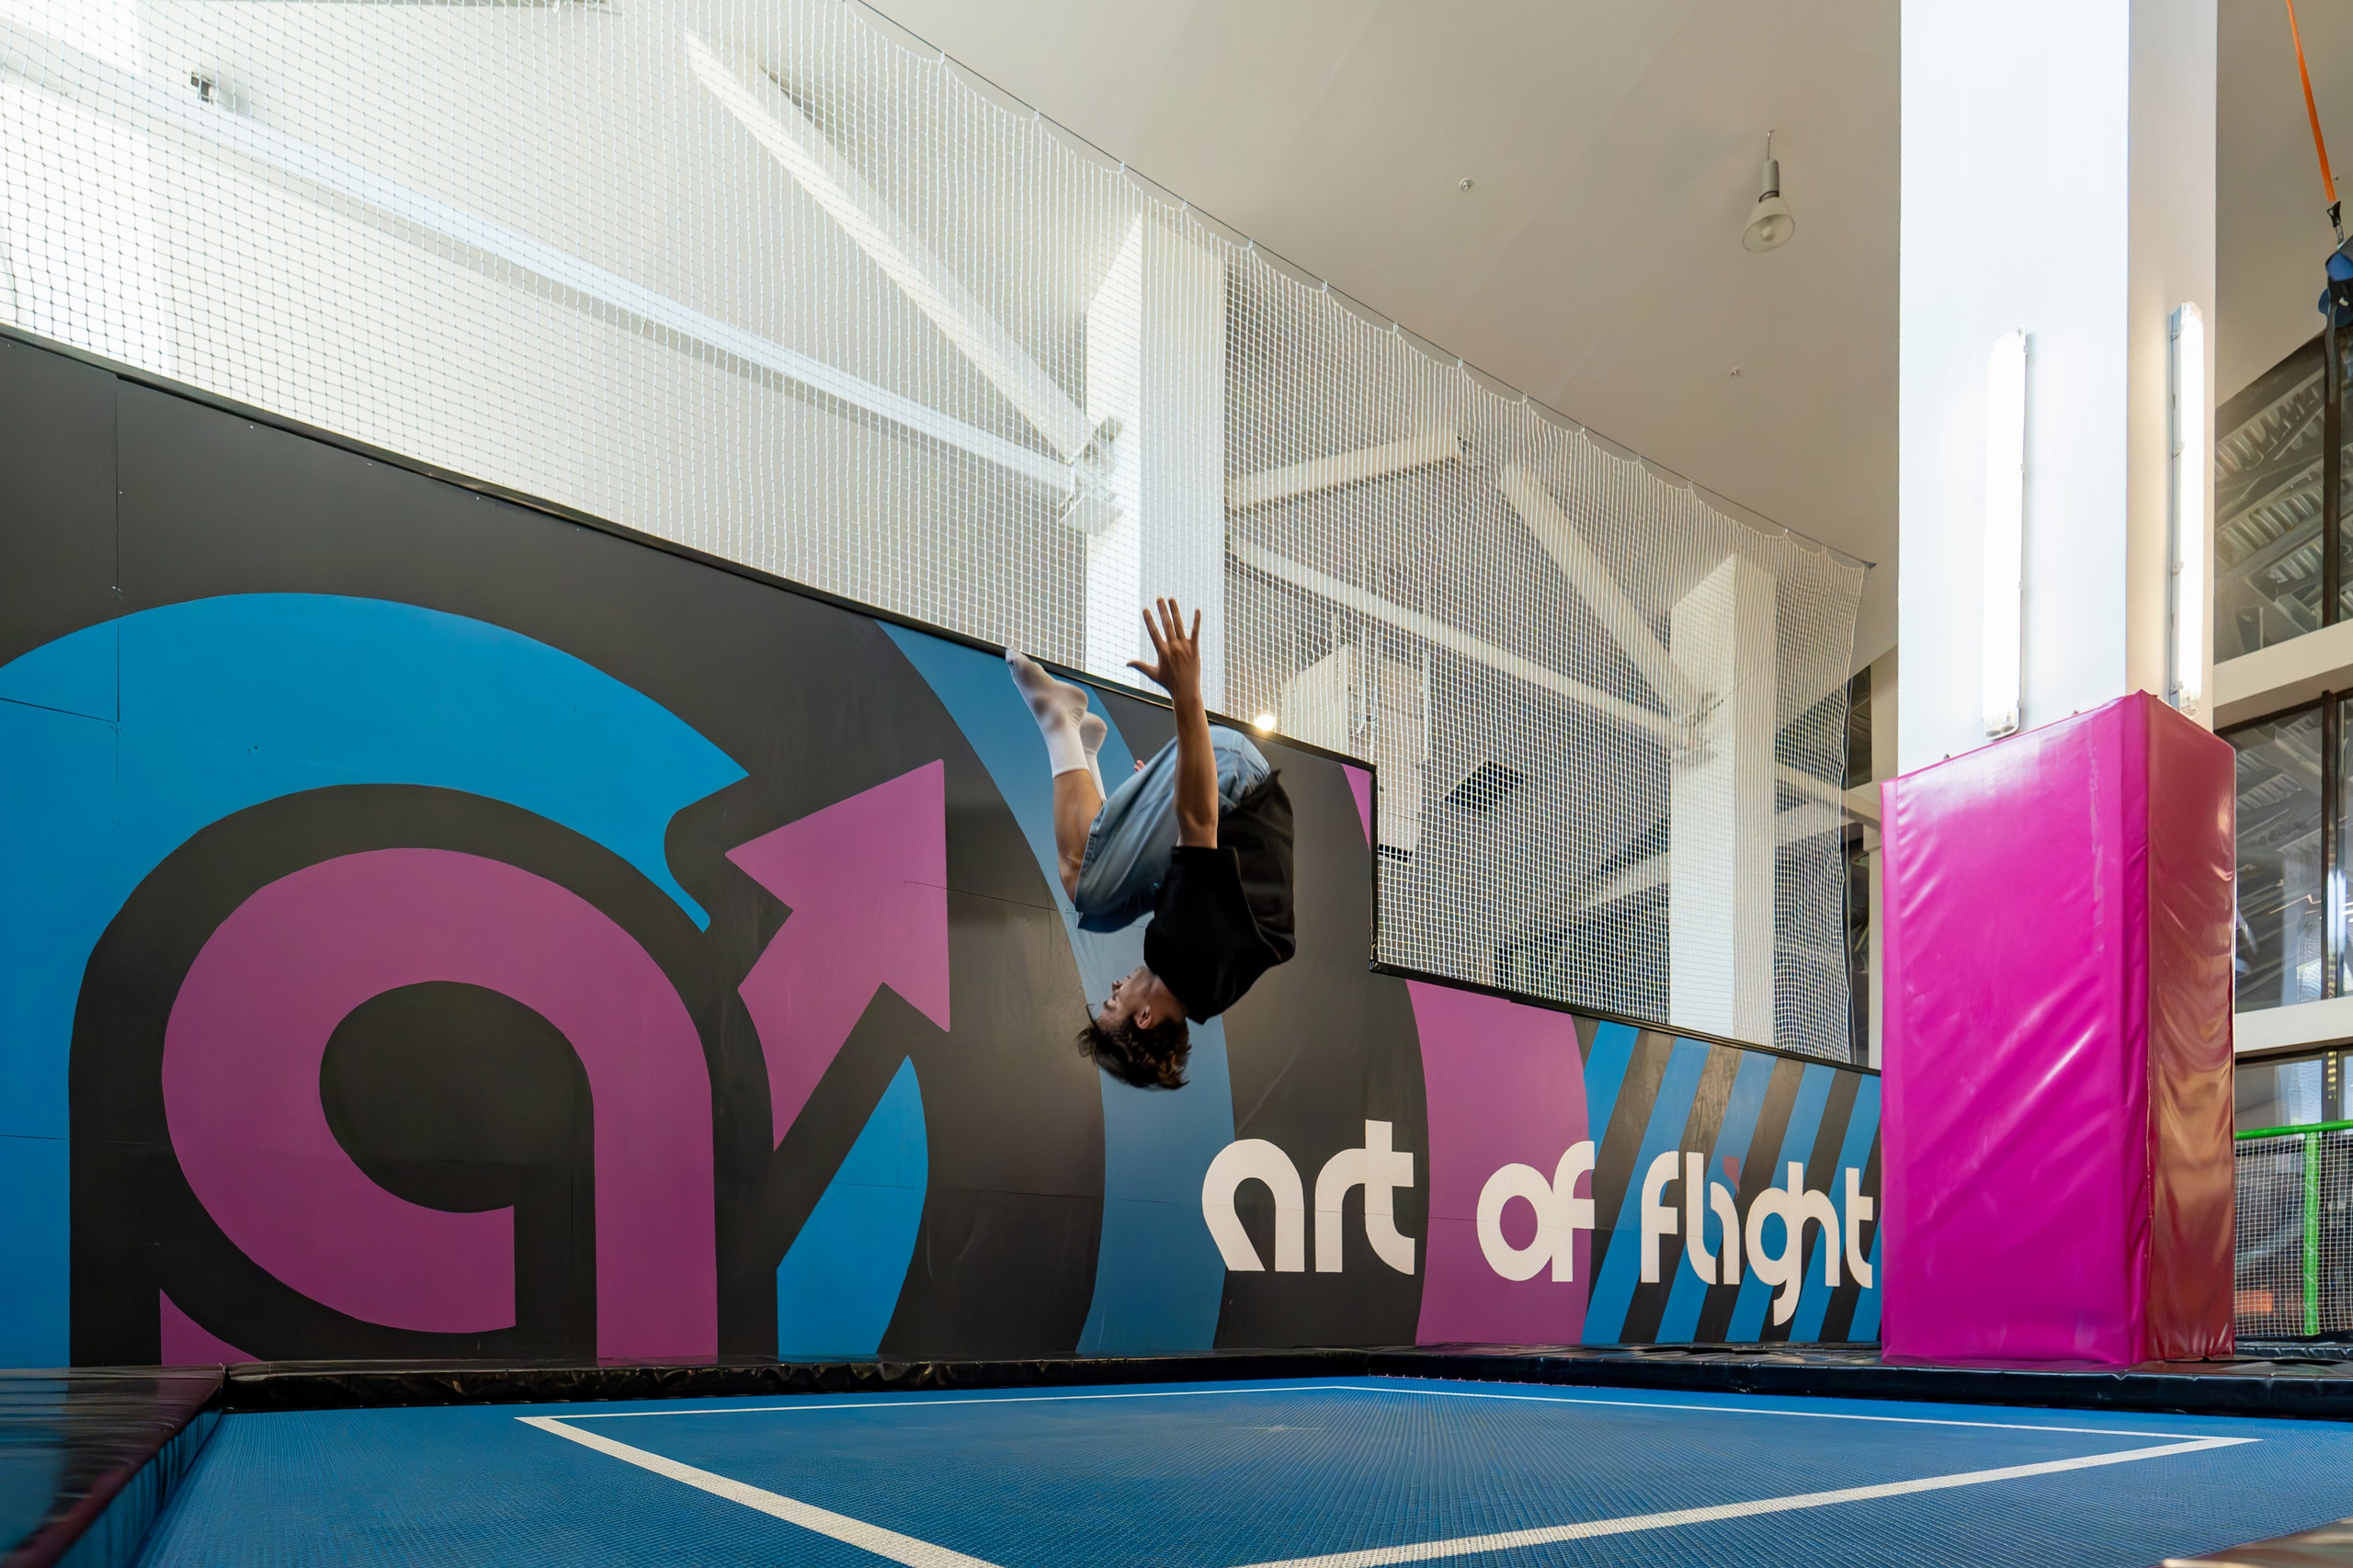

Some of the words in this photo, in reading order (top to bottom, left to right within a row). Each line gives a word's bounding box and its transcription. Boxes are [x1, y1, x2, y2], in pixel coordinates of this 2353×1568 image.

[1201, 1119, 1415, 1275] art
[1476, 1141, 1596, 1282] of
[1641, 1150, 1874, 1326] flight
